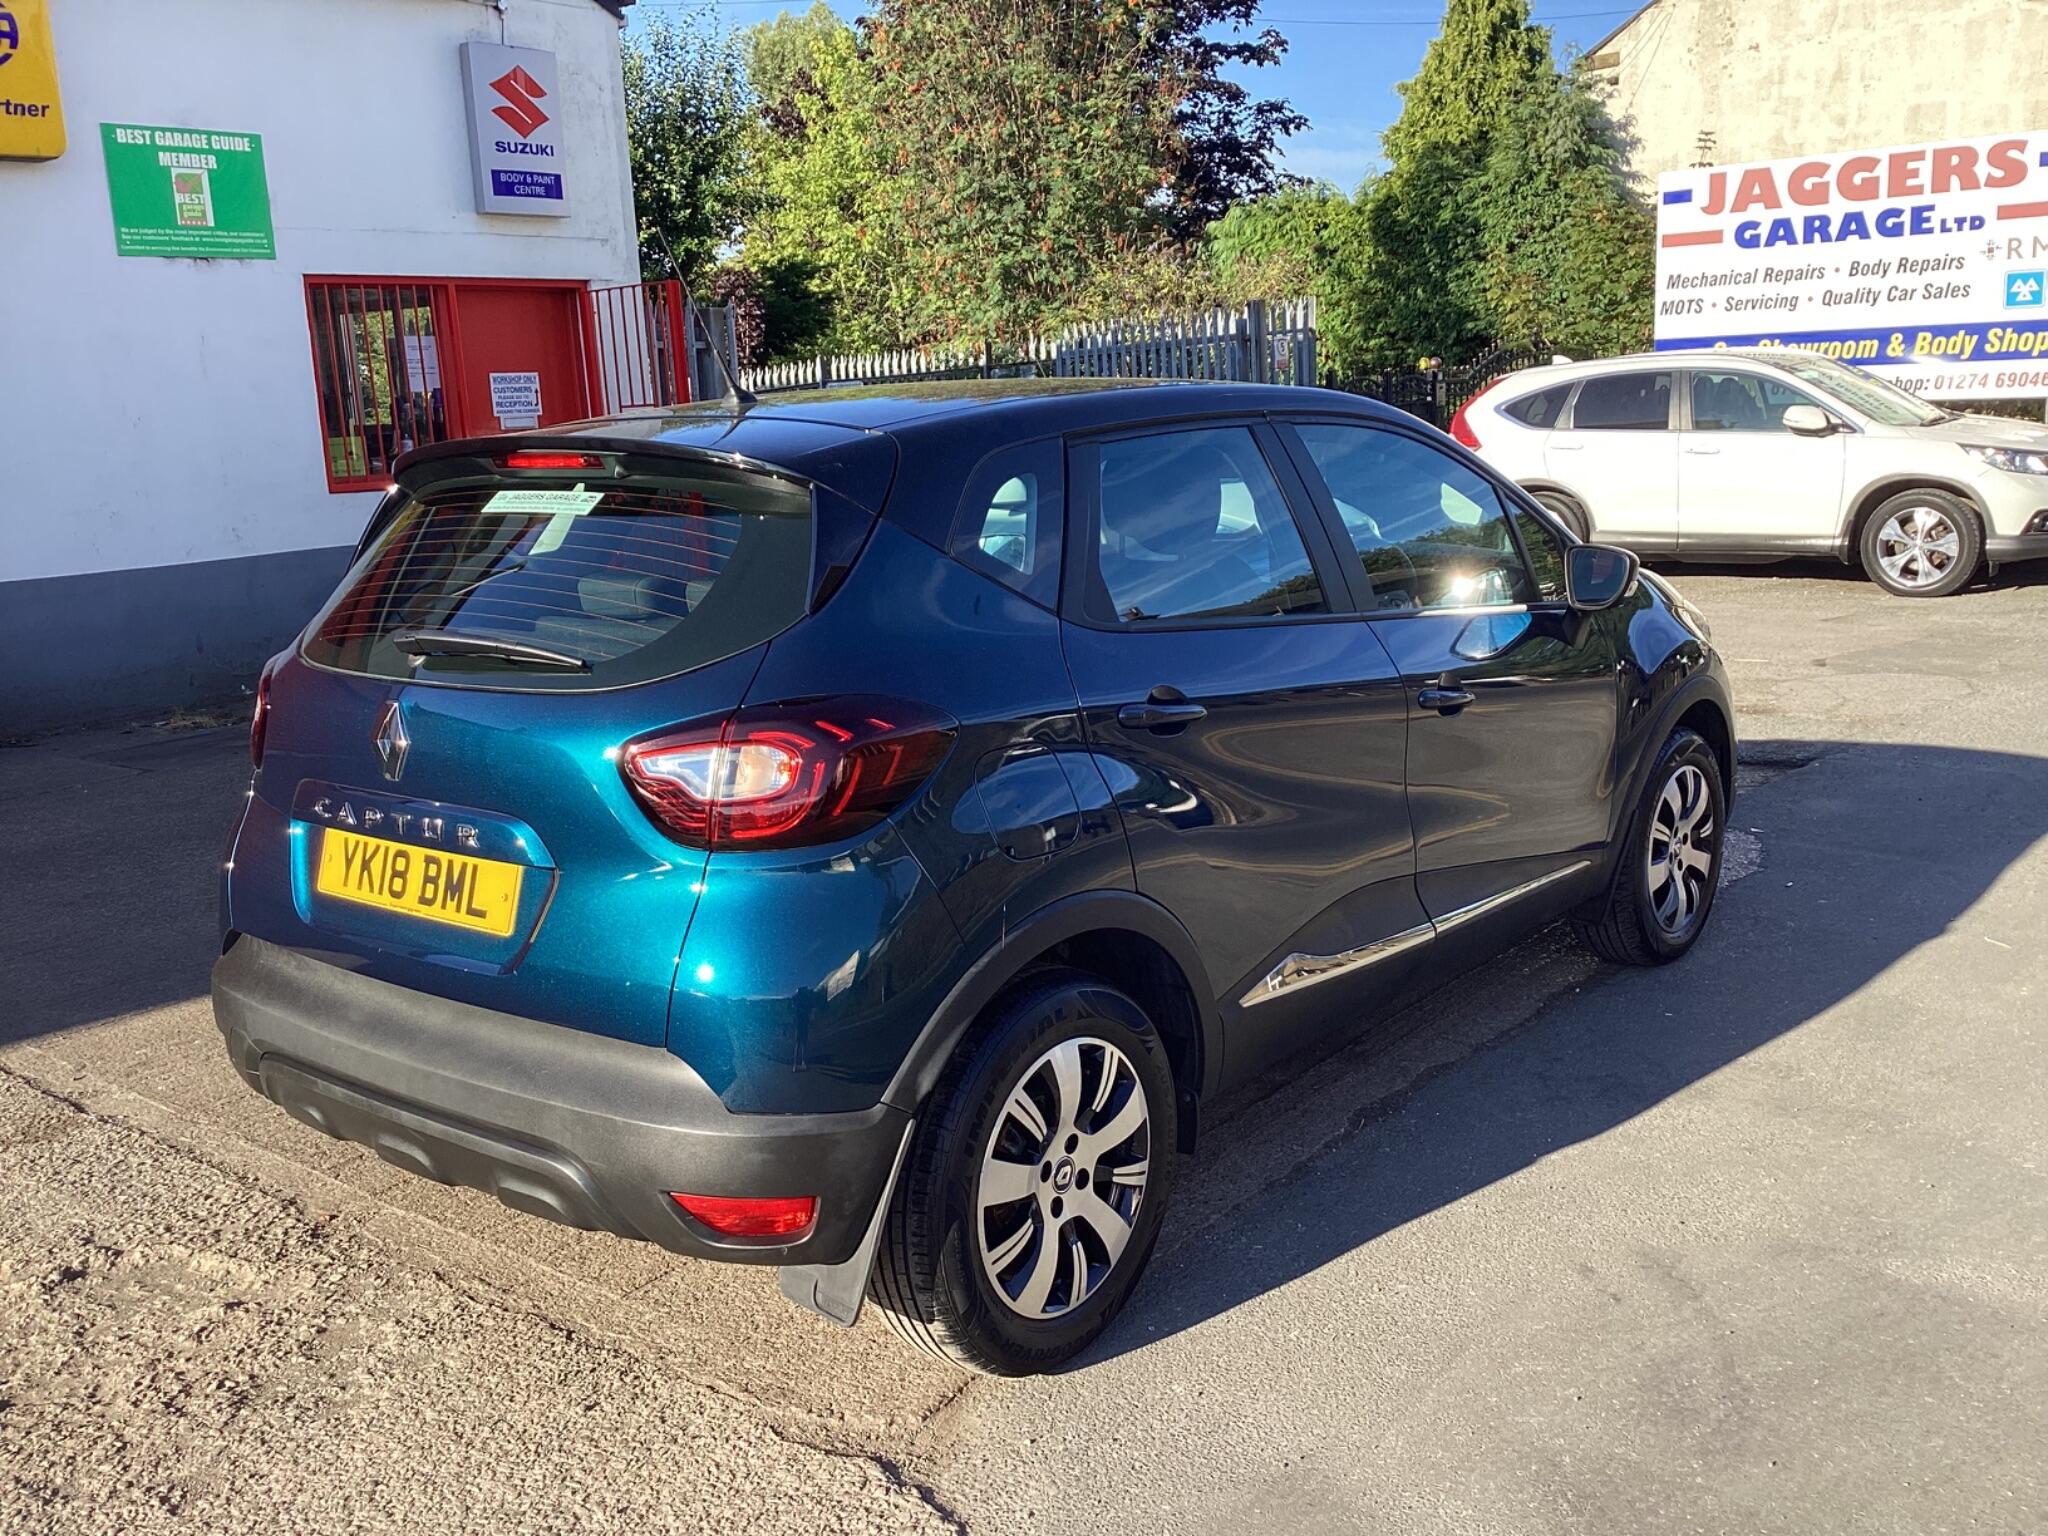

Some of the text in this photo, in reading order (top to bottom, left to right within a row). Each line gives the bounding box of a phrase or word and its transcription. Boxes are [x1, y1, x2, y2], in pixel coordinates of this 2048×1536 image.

[0, 98, 49, 118] tner
[116, 127, 251, 152] BEST GARAGE GUIDE
[495, 141, 554, 157] SUZUKI
[158, 151, 217, 169] MEMBER
[501, 173, 555, 185] BODY & PAINT
[1700, 139, 2029, 216] JAGGERS
[176, 193, 205, 205] BEST
[514, 185, 546, 196] CENTRE
[1734, 204, 1985, 250] GARAGE LTD
[1666, 253, 1966, 290] Mechanical Repairs Body Repairs
[1660, 282, 1972, 316] MOTS Servicing Quality Car Sales
[1758, 326, 2048, 361] wroom & Body Shop
[493, 385, 532, 394] CUSTOMERS
[1888, 375, 1931, 394] hop:
[1934, 372, 1990, 390] 01274
[496, 400, 533, 408] RECEPTION
[314, 797, 480, 848] CAPTUR
[342, 836, 488, 920] YK18 BML
